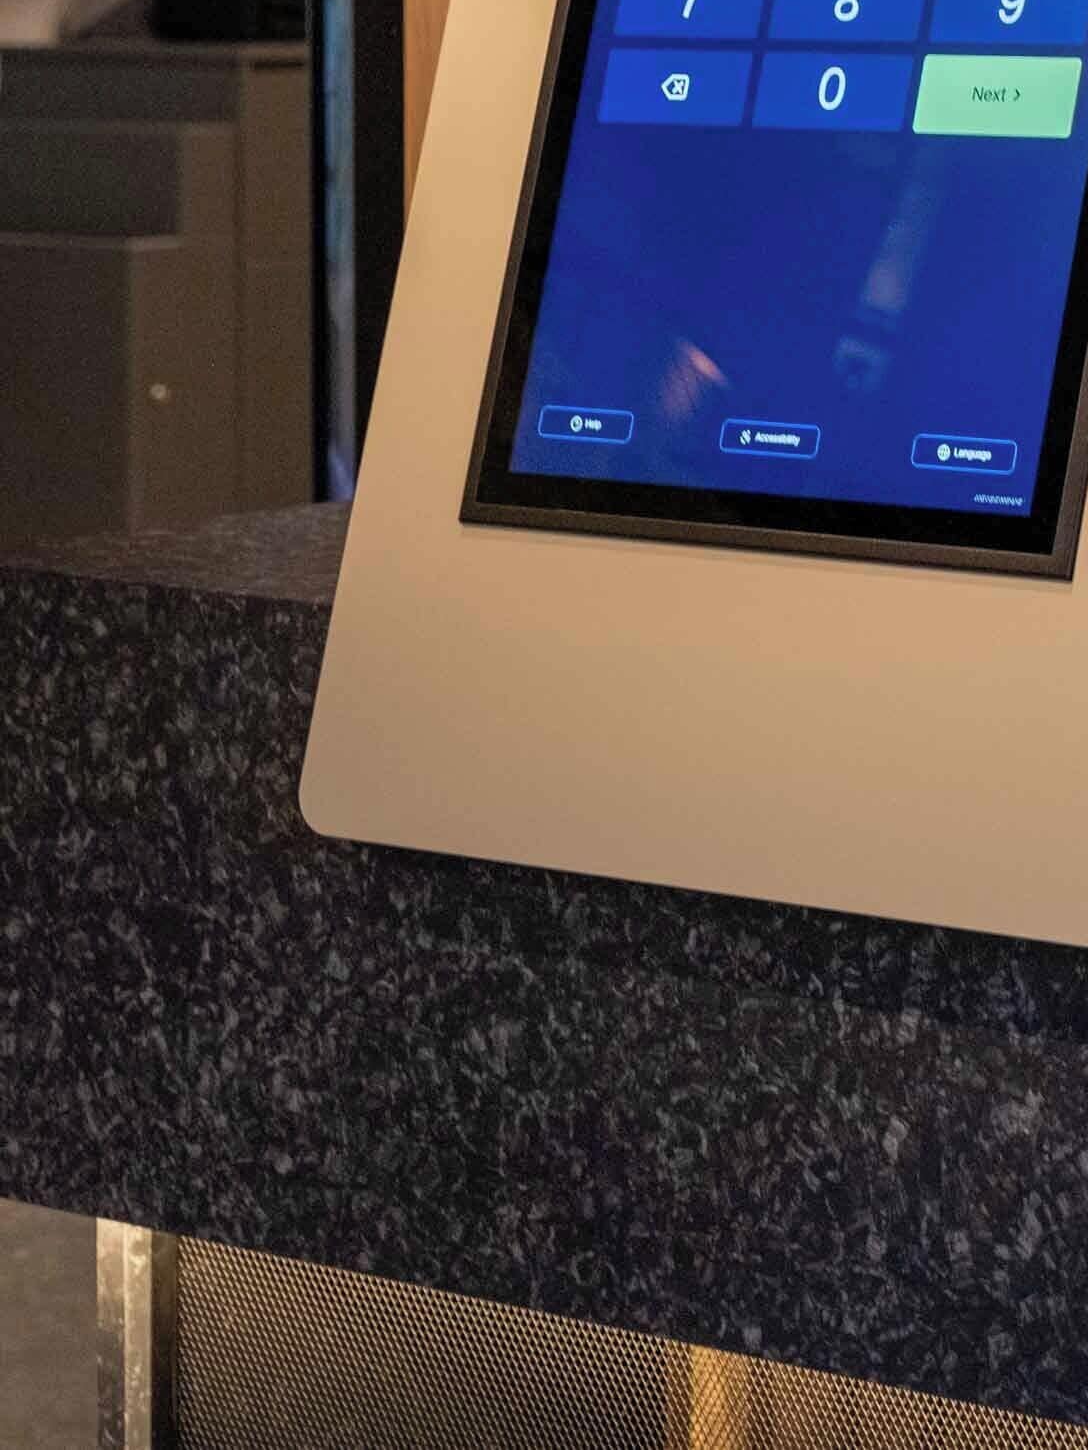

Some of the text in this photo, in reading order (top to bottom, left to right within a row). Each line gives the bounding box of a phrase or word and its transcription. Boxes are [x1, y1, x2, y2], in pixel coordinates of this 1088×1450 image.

[818, 66, 1006, 111] 0 Next
[953, 447, 992, 462] Language
